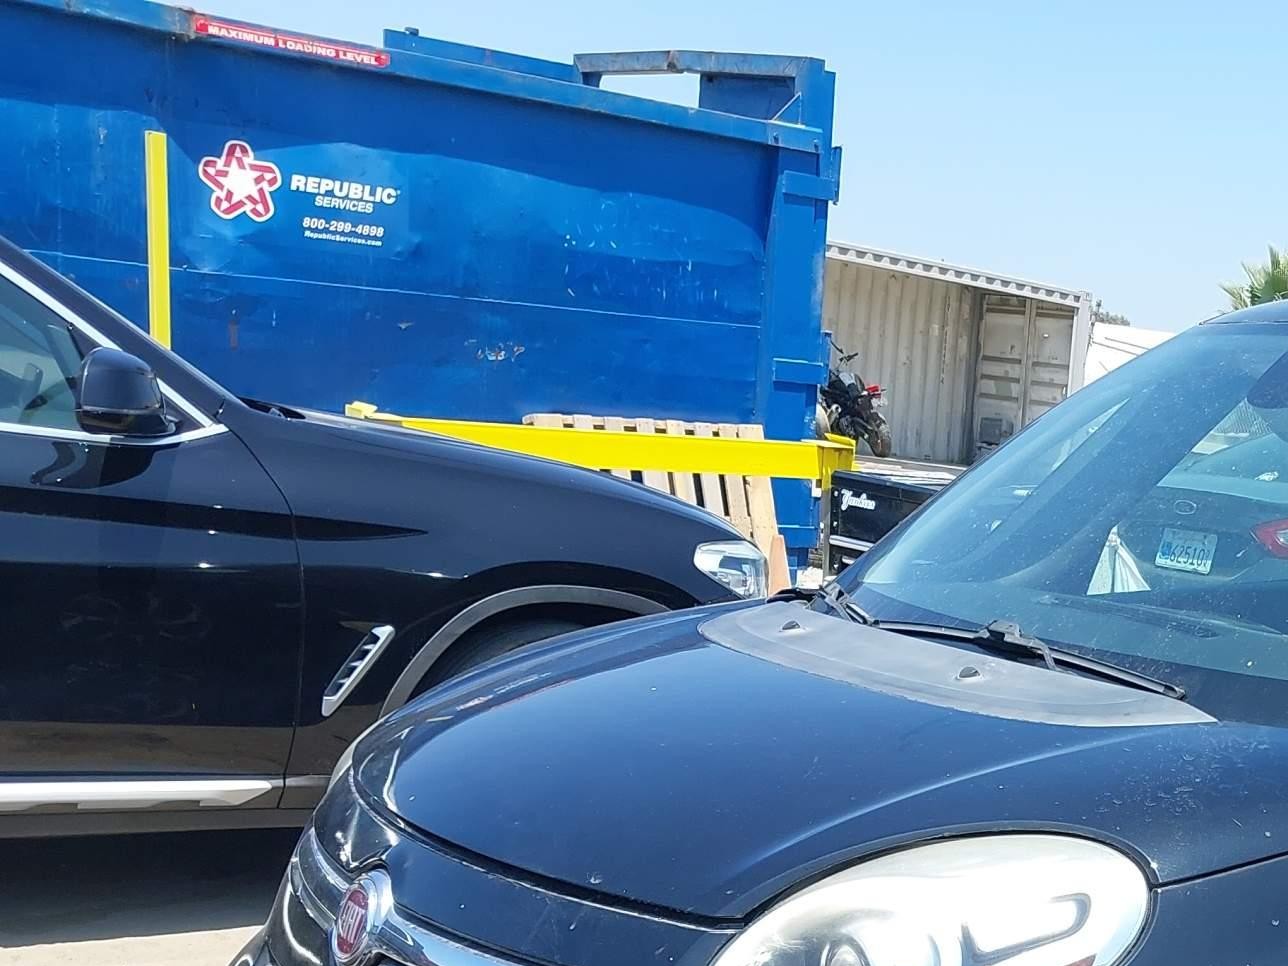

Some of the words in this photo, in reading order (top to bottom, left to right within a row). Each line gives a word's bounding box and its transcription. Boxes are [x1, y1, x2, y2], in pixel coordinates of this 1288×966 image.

[208, 26, 275, 46] MAXIMUM
[278, 40, 336, 57] LOADING
[339, 51, 379, 65] LEVEL
[314, 195, 374, 213] SERVICES
[302, 217, 385, 237] 800-299-4898
[304, 230, 382, 246] RepublicServices.com
